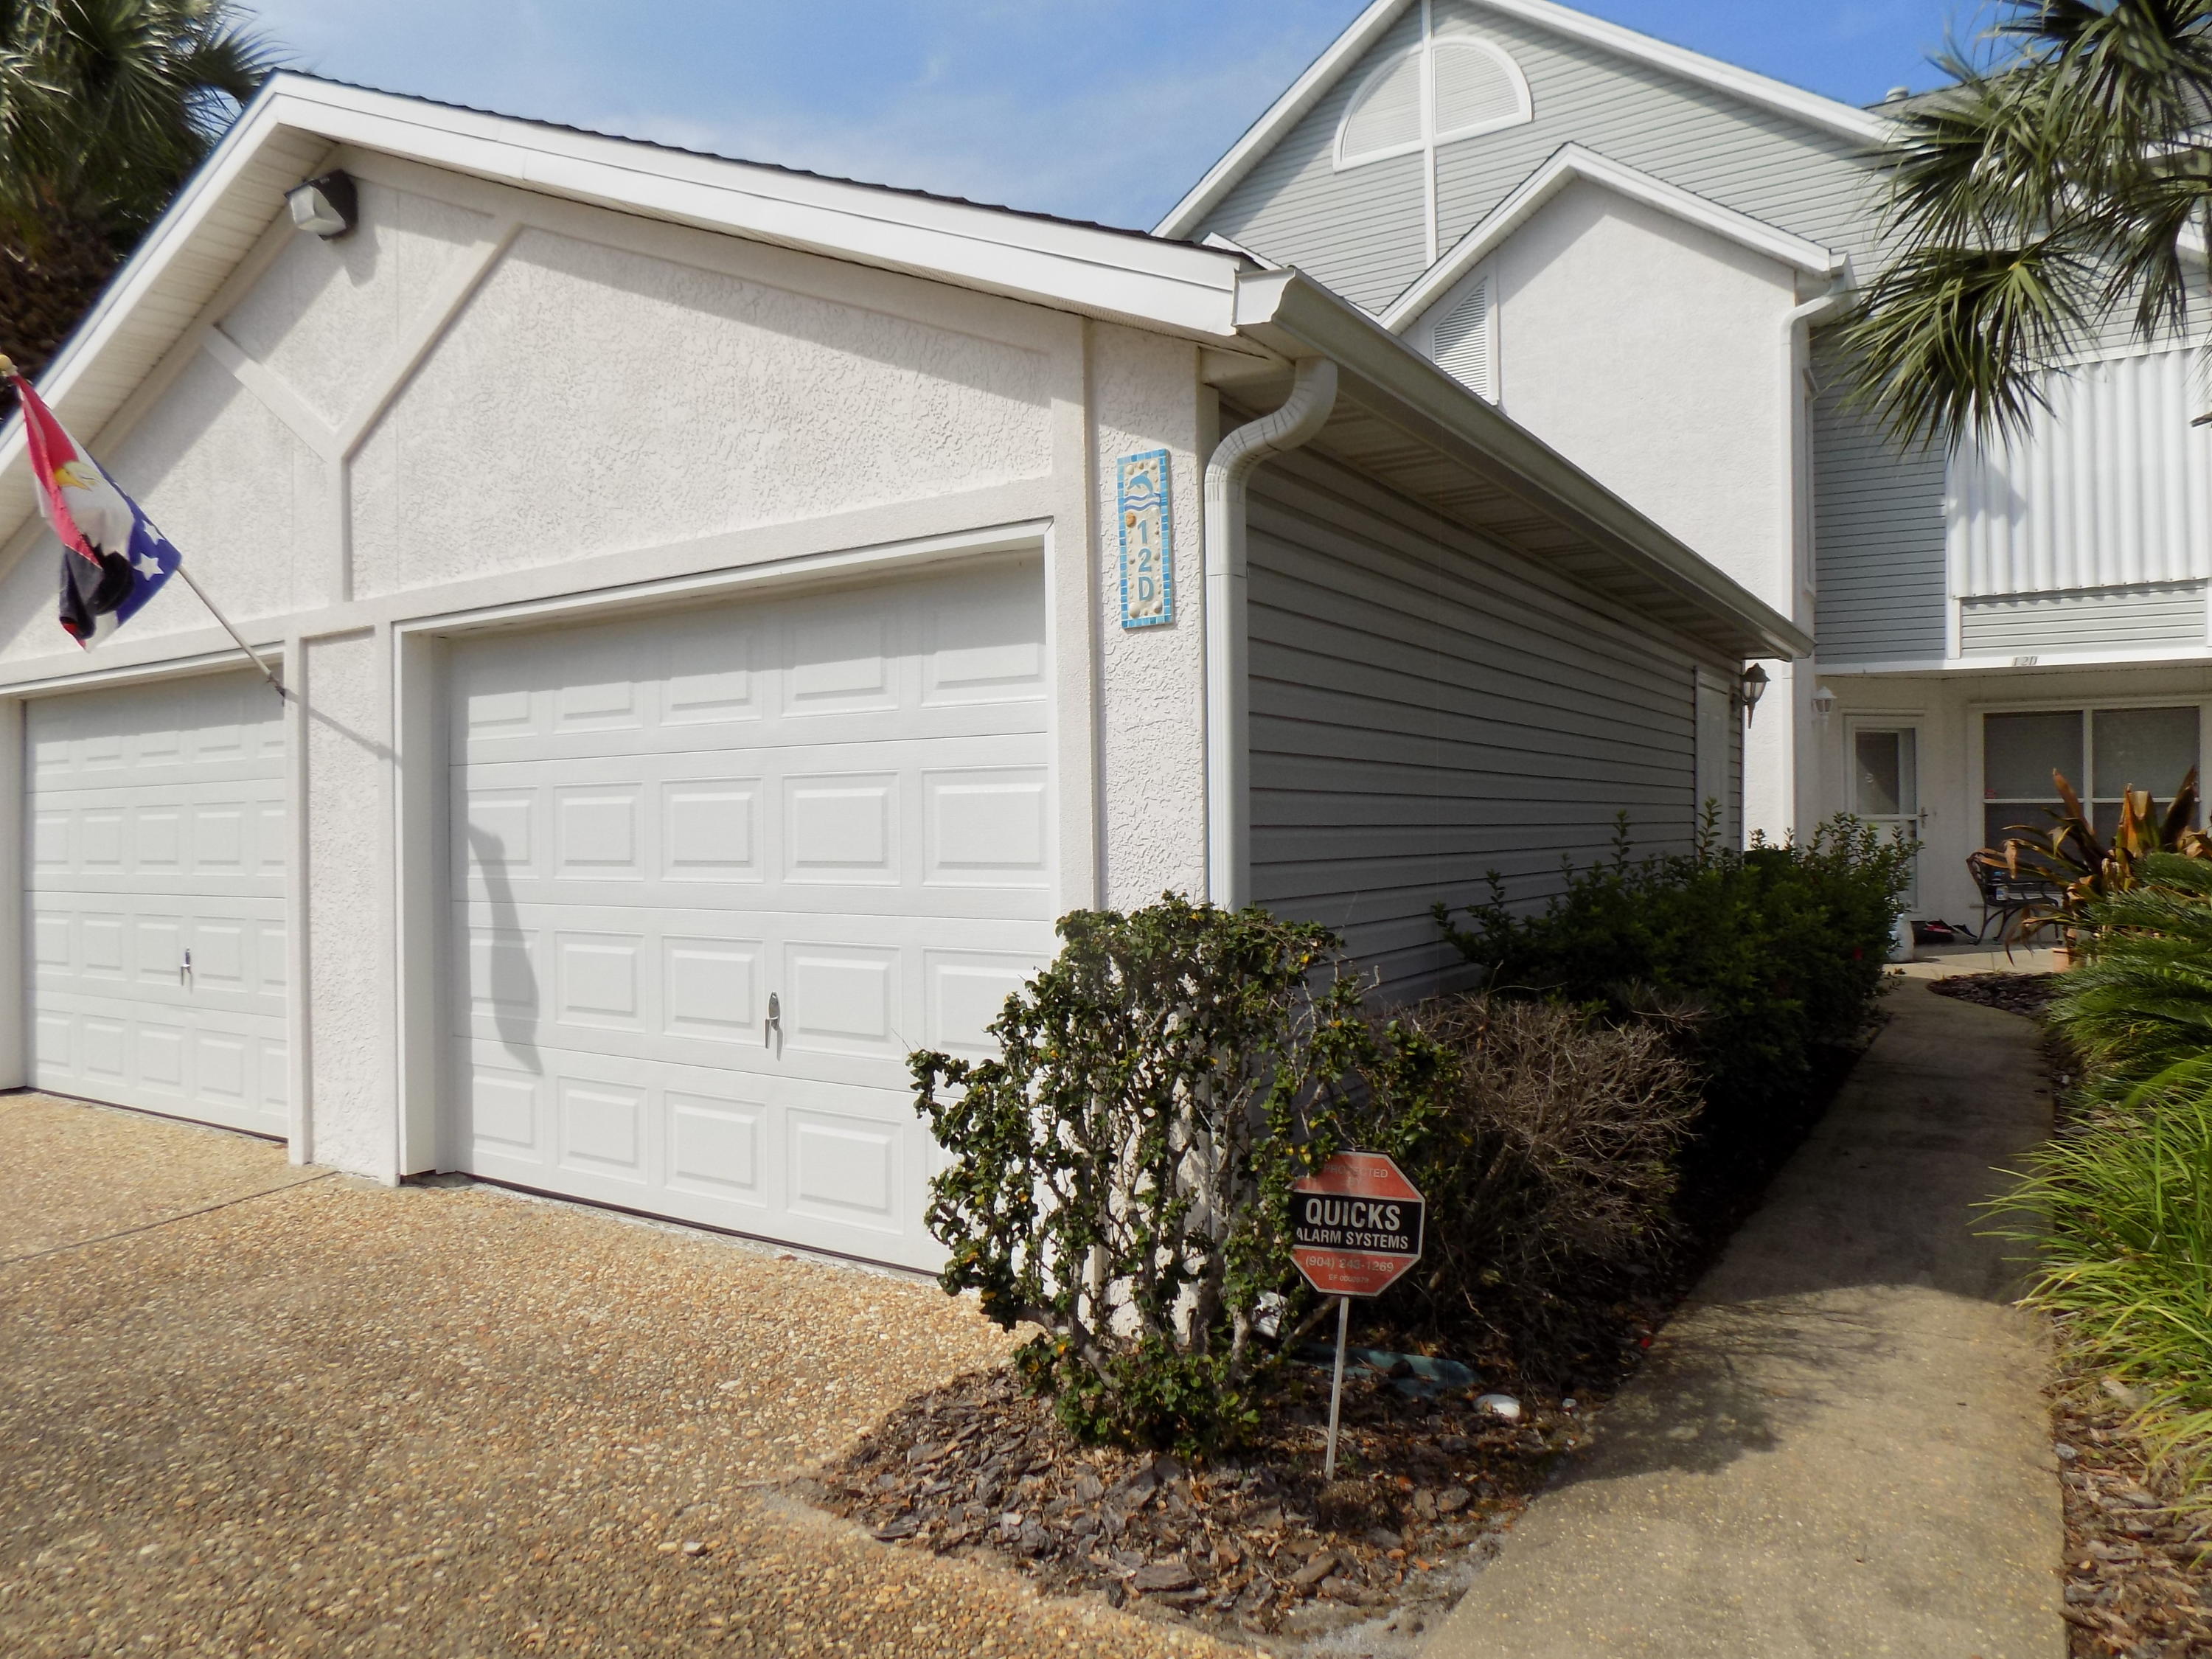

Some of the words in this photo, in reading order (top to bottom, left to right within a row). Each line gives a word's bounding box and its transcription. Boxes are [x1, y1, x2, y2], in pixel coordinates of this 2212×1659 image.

[1137, 520, 1155, 602] 12D
[1323, 1164, 1388, 1178] PROECTED
[1306, 1198, 1401, 1231] QUICKS
[1296, 1227, 1341, 1245] ALARM
[1346, 1231, 1408, 1250] SYSTEMS
[1305, 1256, 1335, 1270] (904)
